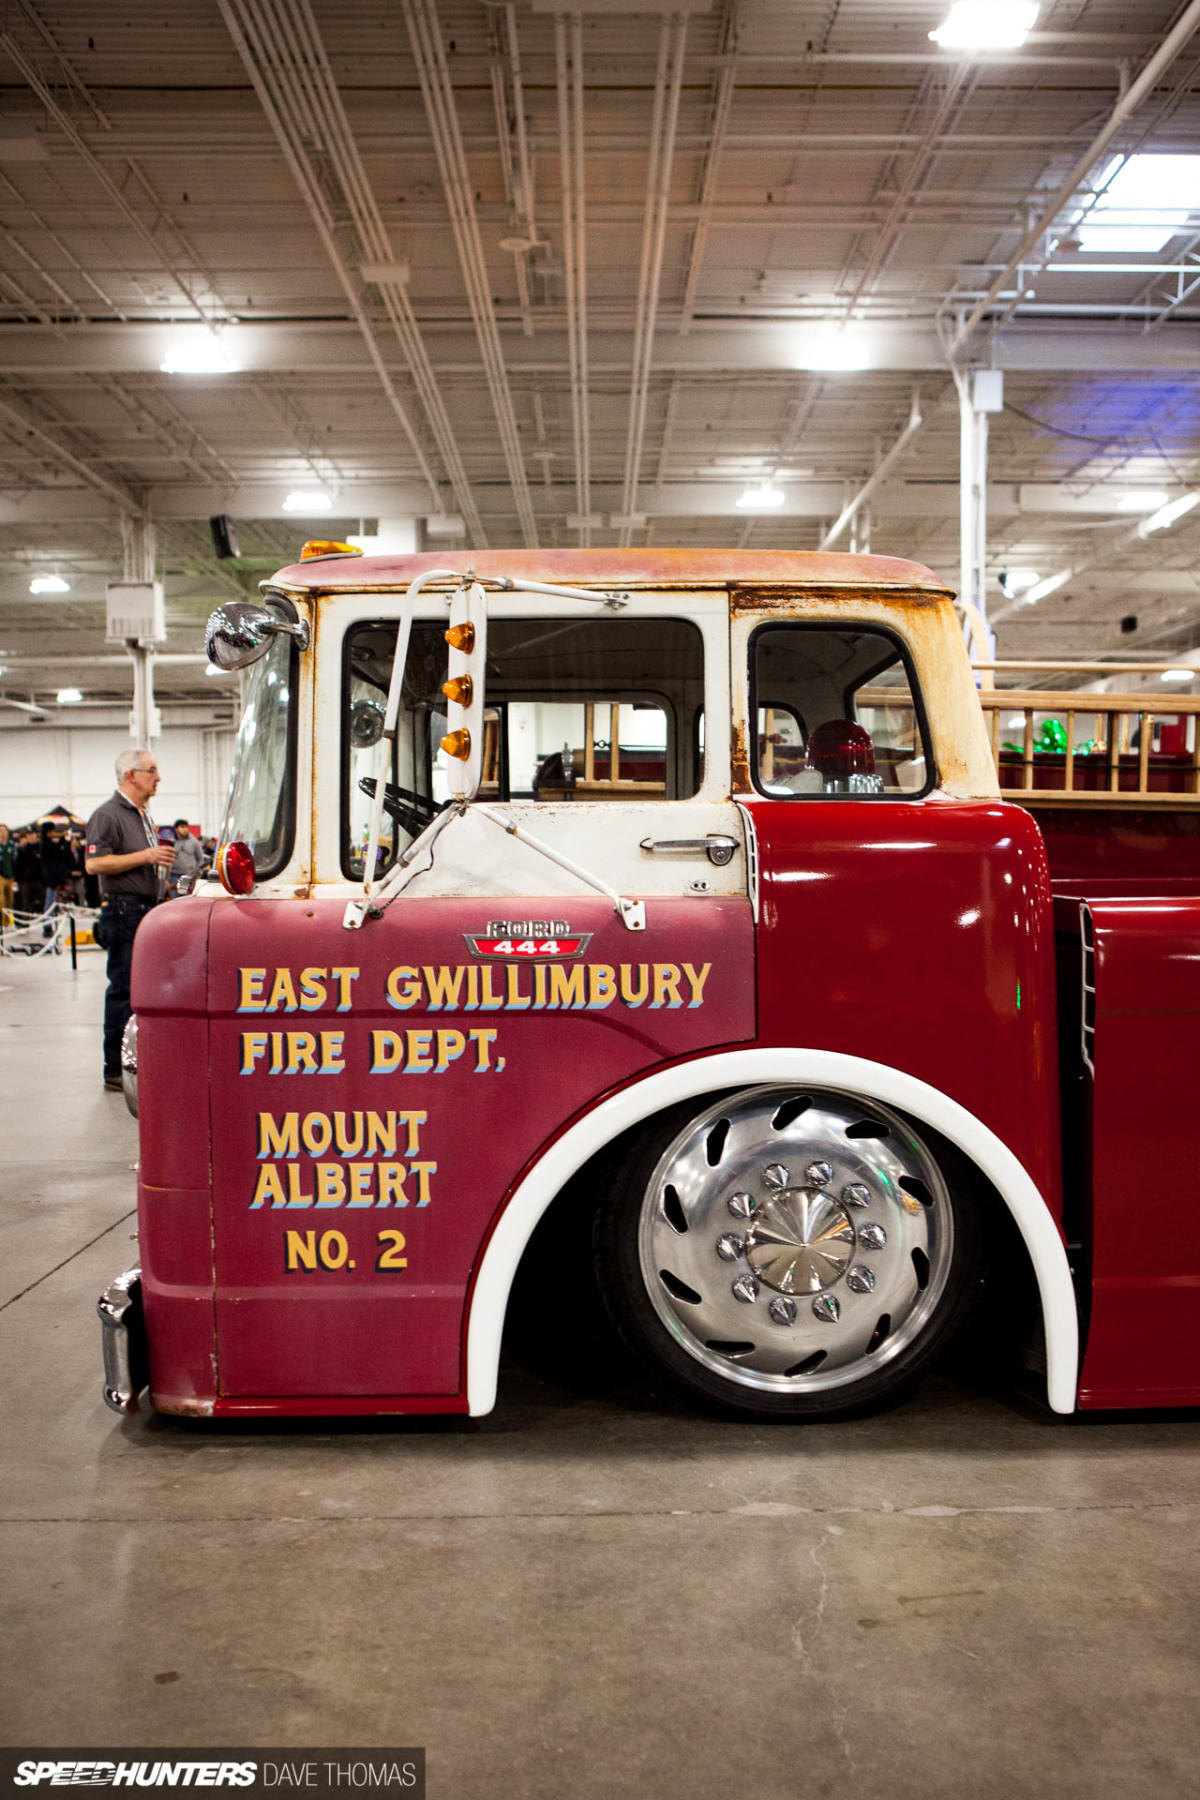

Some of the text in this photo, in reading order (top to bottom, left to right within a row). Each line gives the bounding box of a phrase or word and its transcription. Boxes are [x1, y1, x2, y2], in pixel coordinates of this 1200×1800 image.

[486, 920, 571, 937] FORD
[493, 940, 560, 954] 444
[236, 963, 713, 1013] EAST GWILLIMBURY
[239, 1029, 506, 1075] FIRE DEPT.
[257, 1111, 428, 1158] MOUNT
[249, 1162, 438, 1208] ALBERT
[285, 1230, 409, 1273] NO. 2
